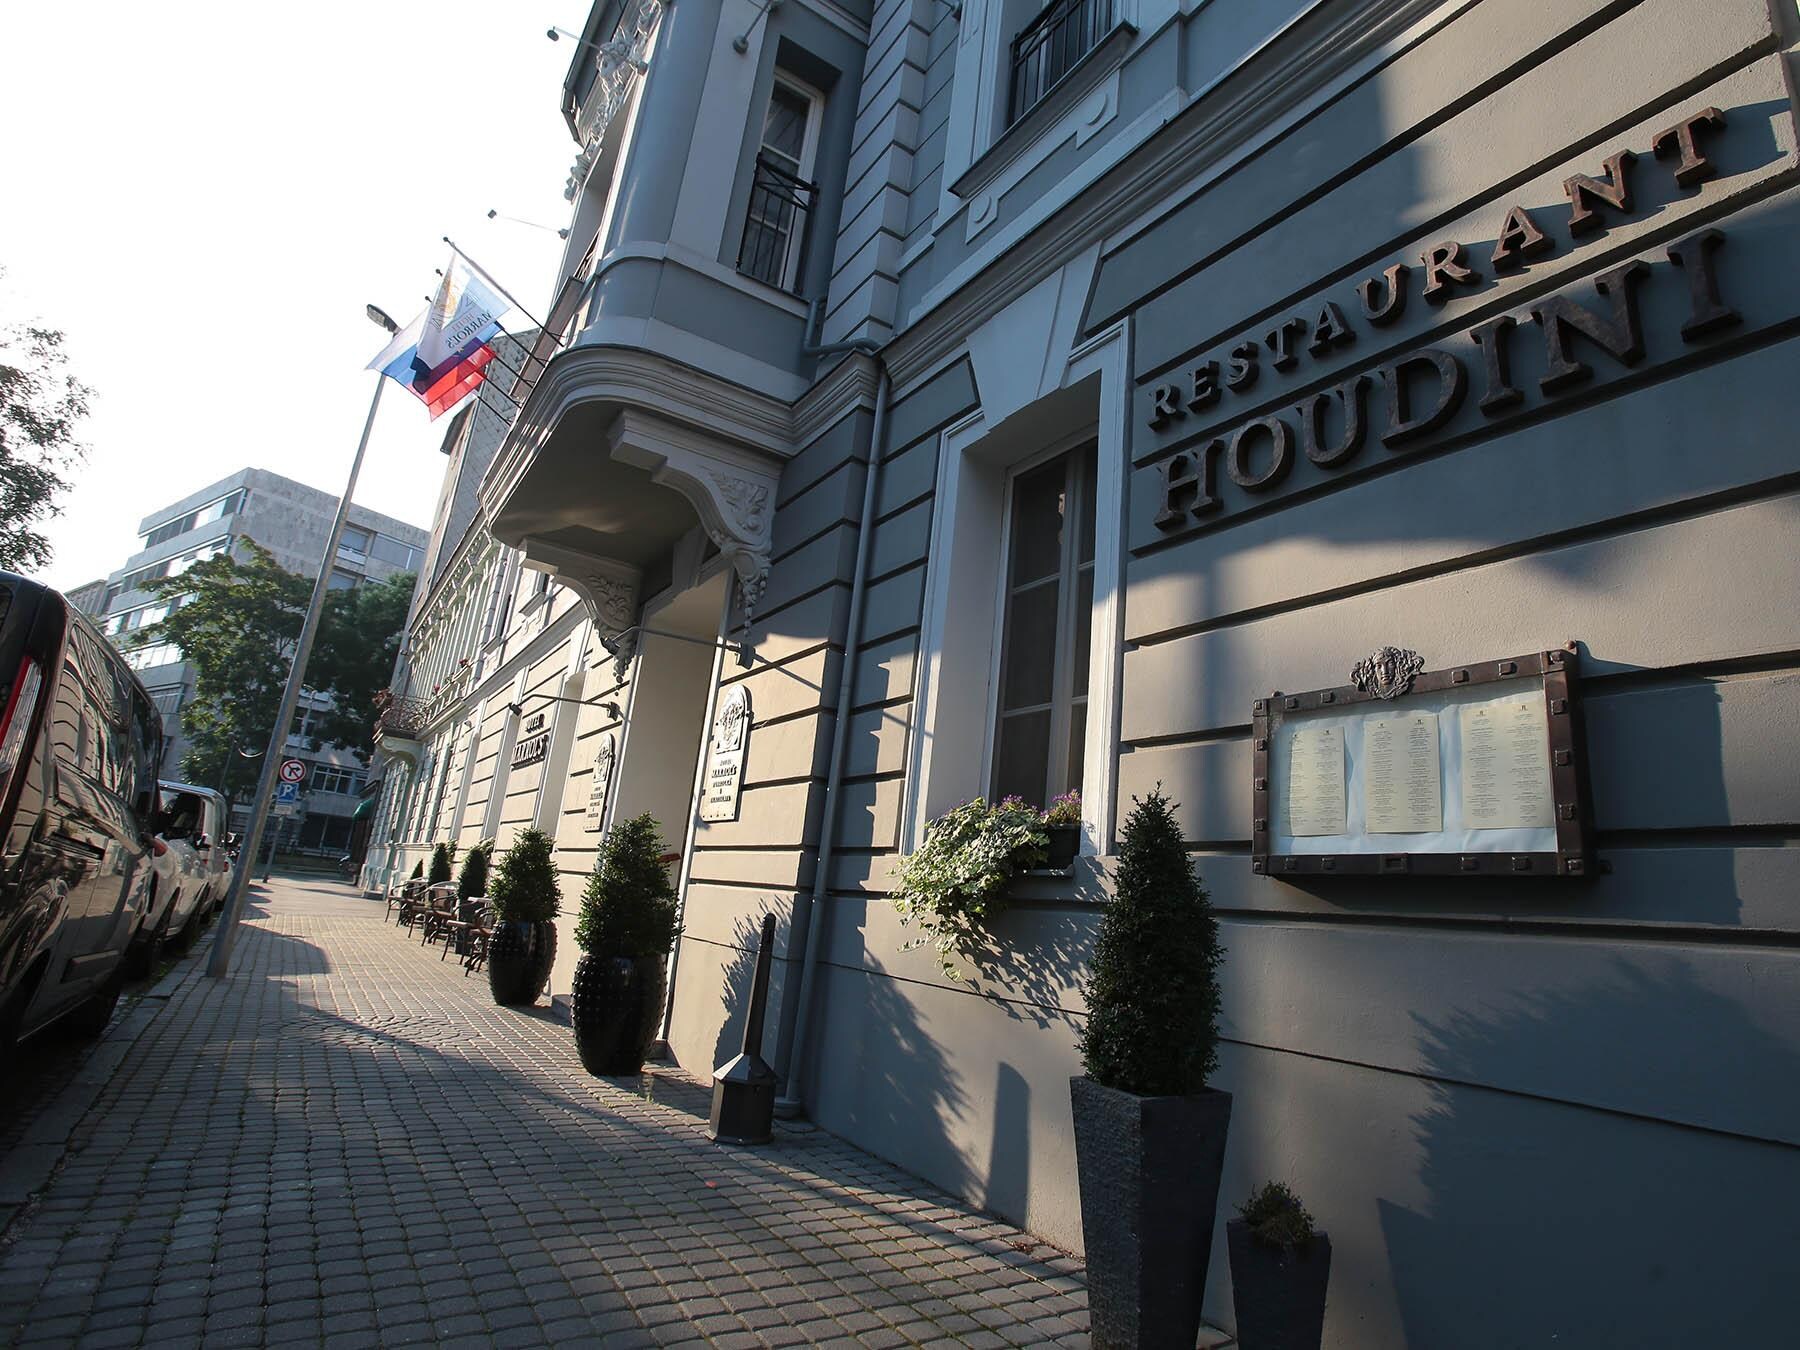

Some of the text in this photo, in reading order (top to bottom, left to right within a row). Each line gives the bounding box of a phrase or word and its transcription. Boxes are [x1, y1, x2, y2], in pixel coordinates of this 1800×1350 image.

[1148, 106, 1726, 430] RESTAURANT
[1153, 227, 1741, 530] HOUDINI
[280, 784, 293, 797] P
